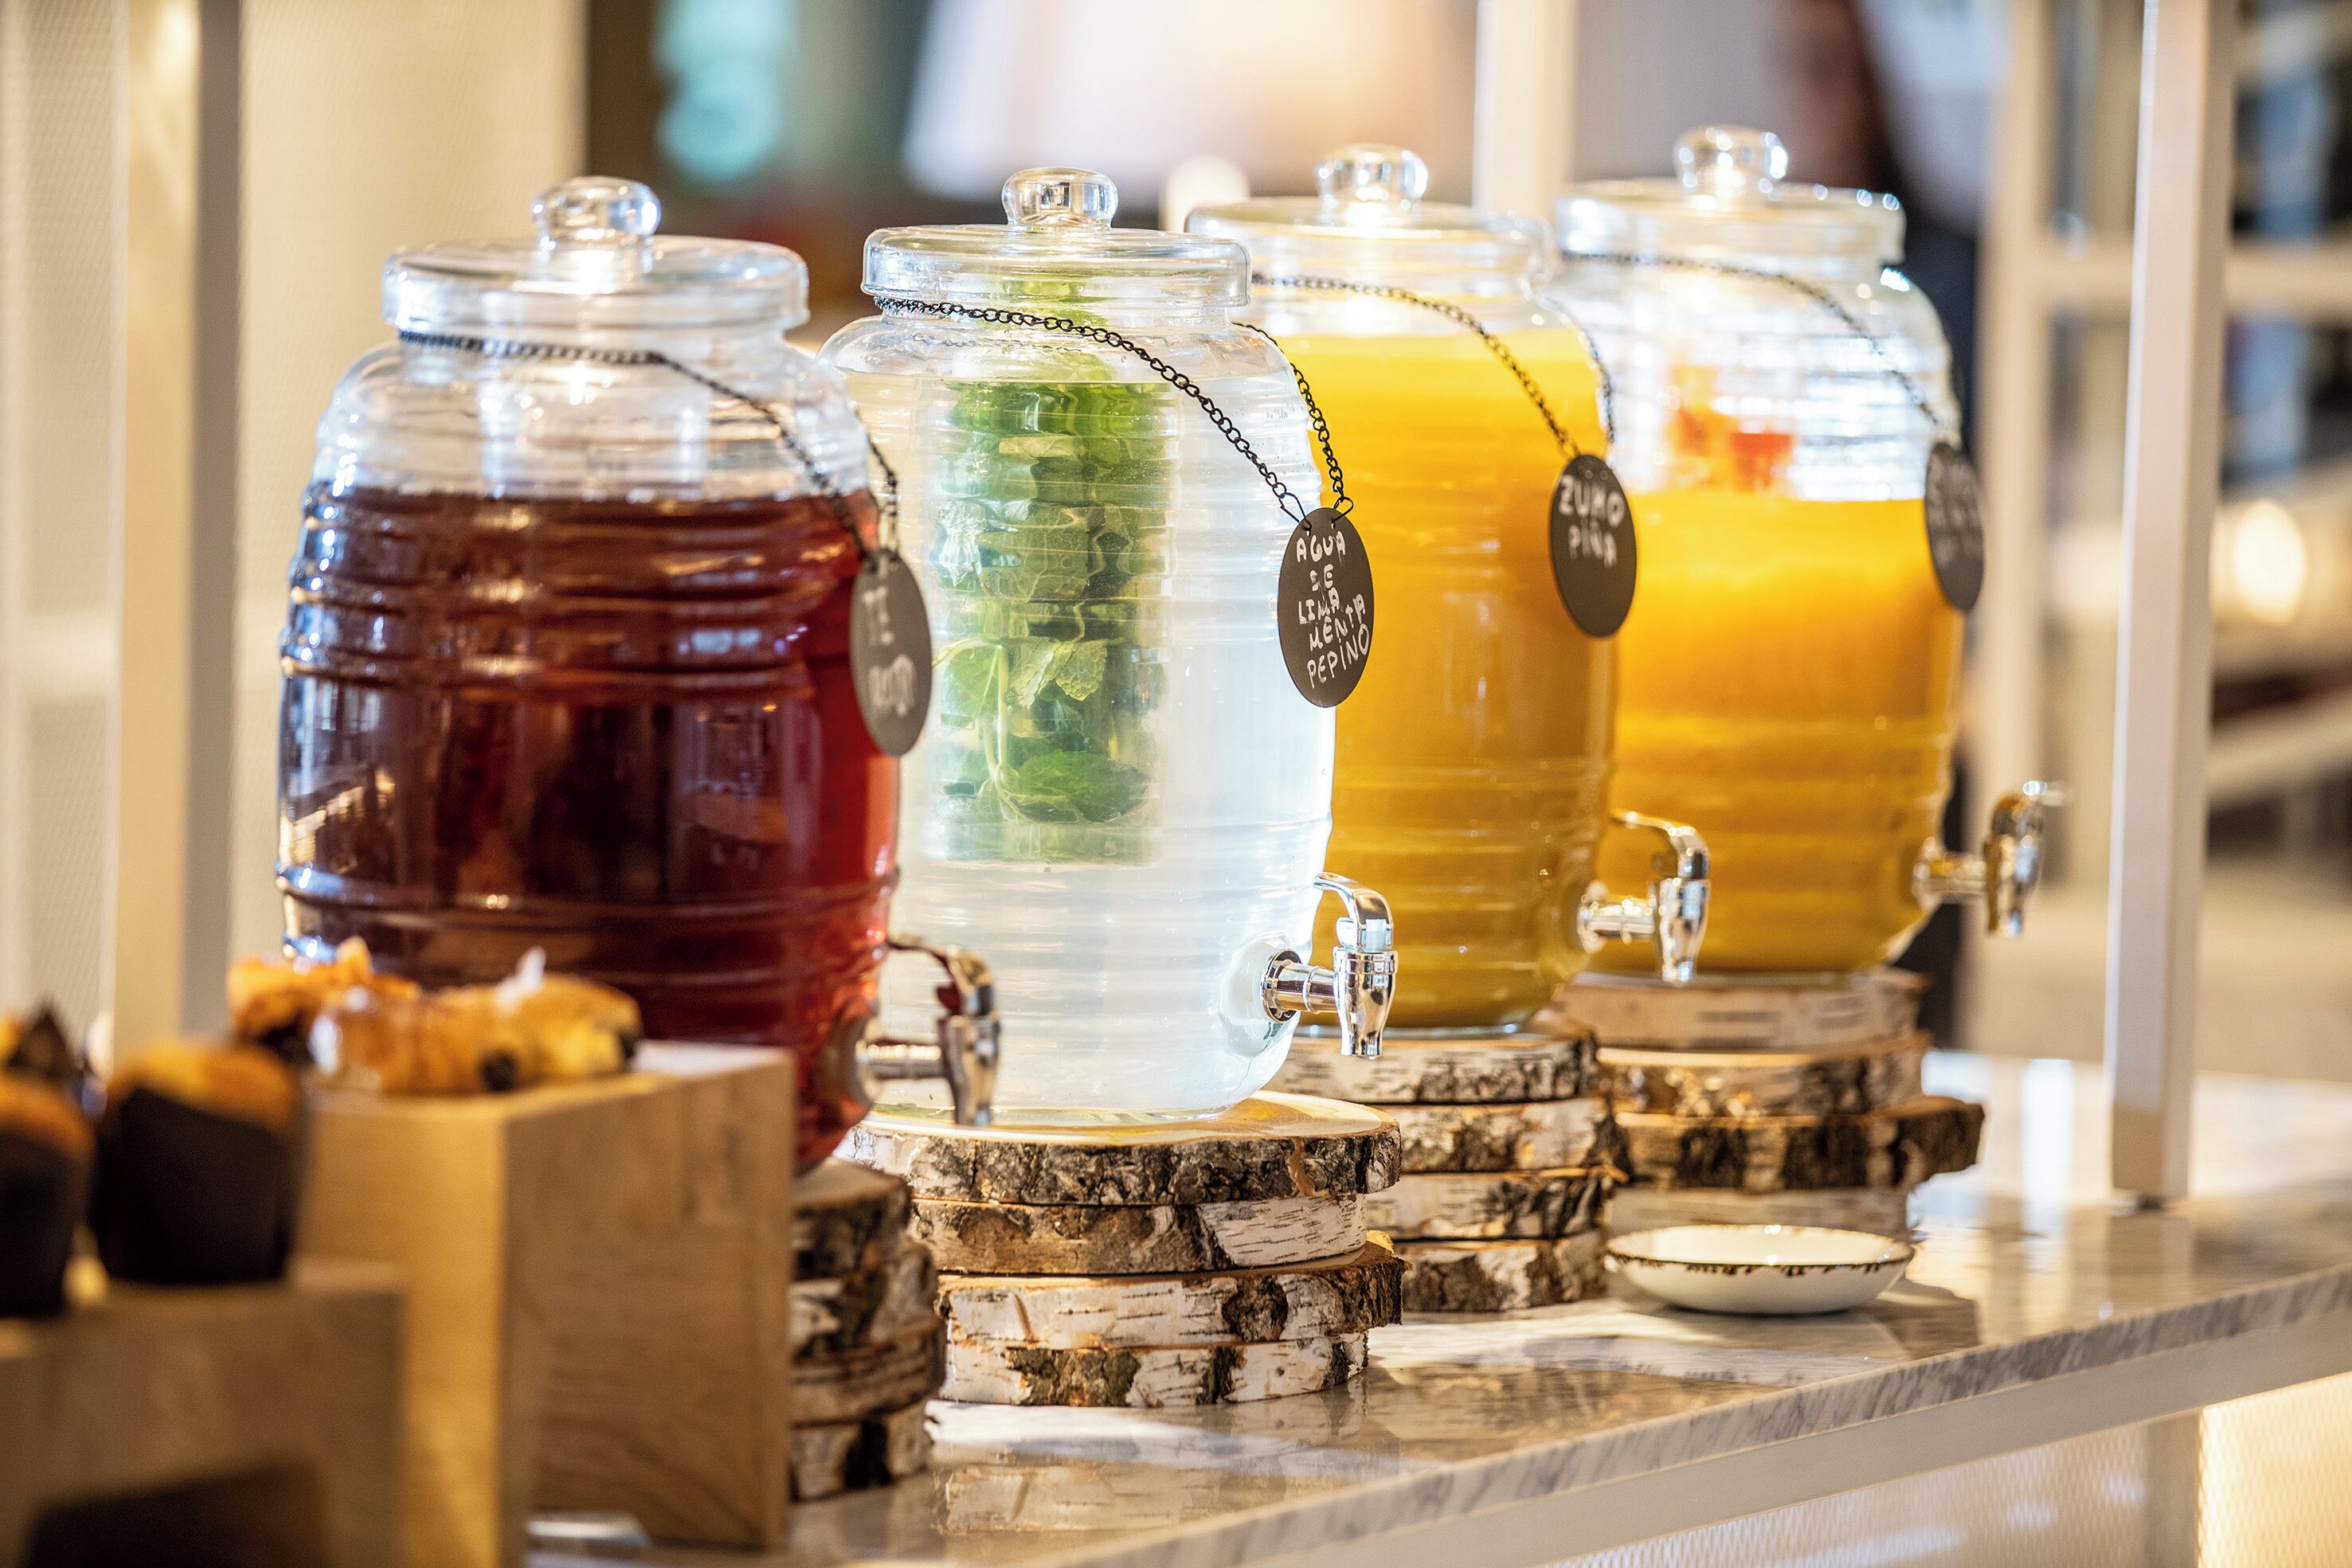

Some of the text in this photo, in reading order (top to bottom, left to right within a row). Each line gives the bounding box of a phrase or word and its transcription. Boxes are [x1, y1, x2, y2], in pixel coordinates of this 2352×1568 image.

[1297, 531, 1346, 562] AGUA
[1298, 587, 1340, 624] LIMA
[1309, 593, 1365, 651] MENTA
